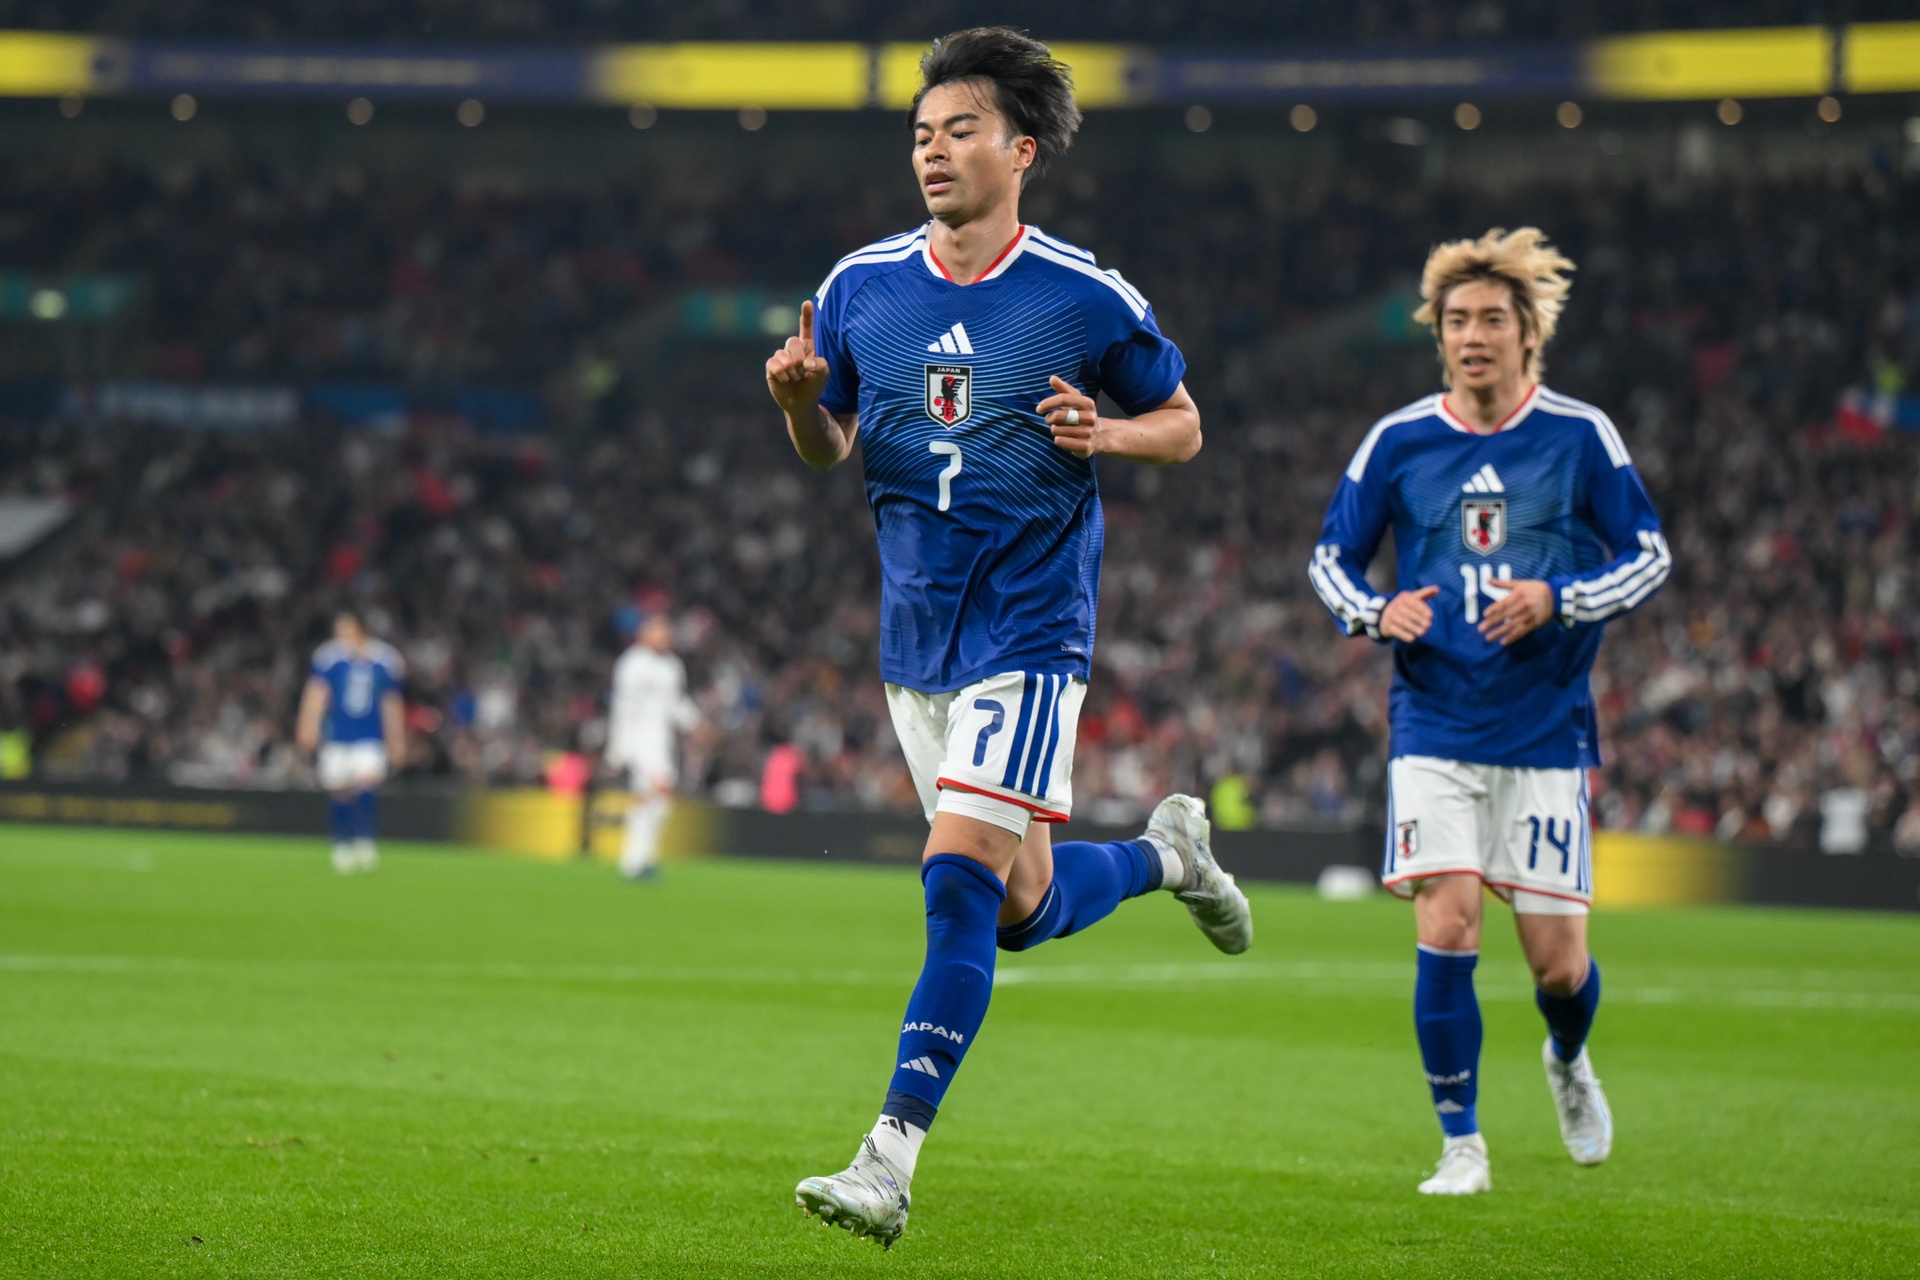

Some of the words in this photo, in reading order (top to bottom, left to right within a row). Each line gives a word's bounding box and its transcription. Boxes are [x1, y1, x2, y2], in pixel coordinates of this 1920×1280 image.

[939, 408, 959, 418] JFA
[930, 441, 962, 511] 7
[1460, 564, 1512, 624] 14
[973, 699, 1005, 766] 7
[1530, 816, 1571, 874] 14
[902, 1022, 964, 1044] JAPAN
